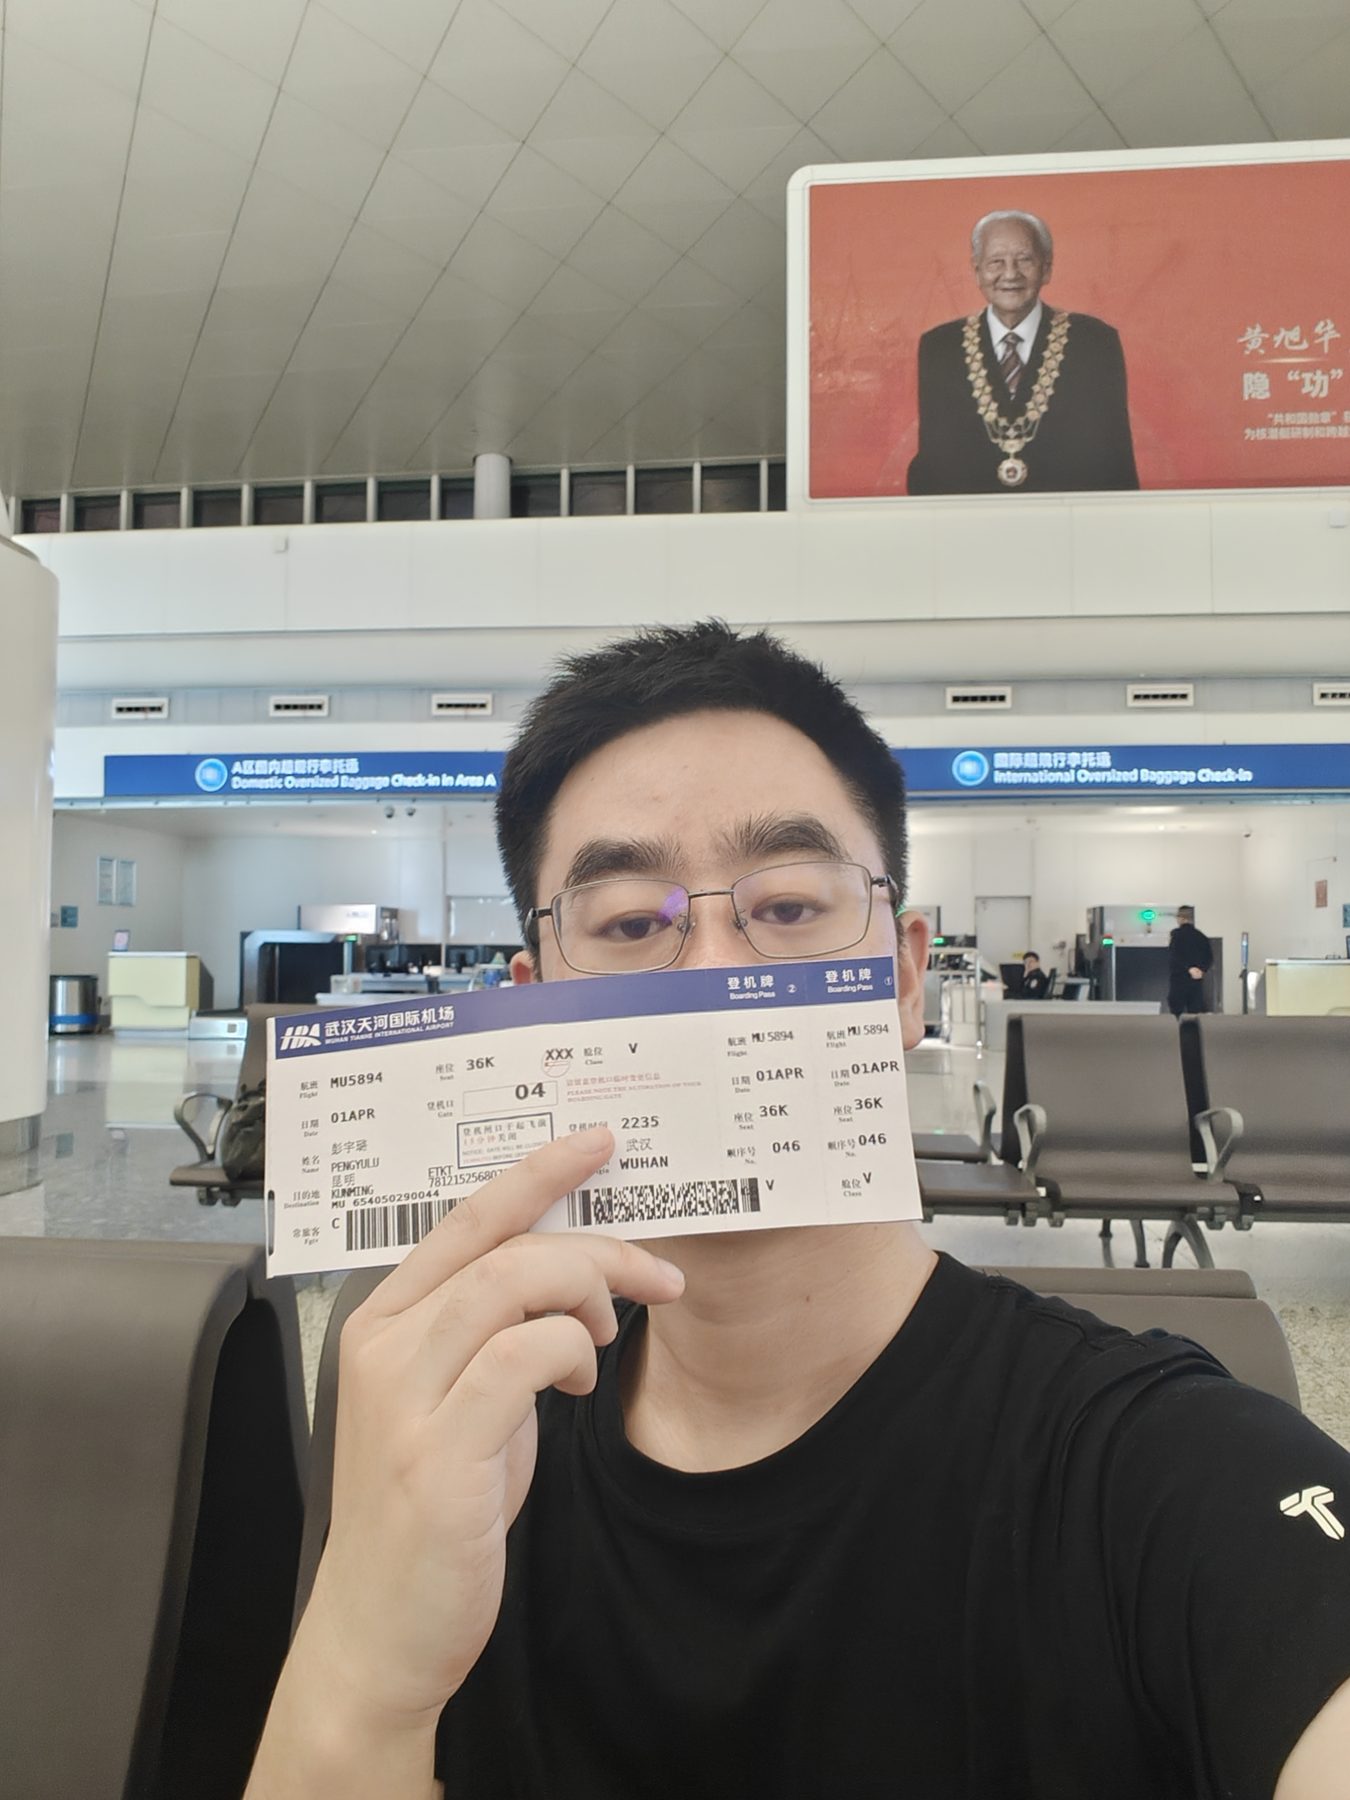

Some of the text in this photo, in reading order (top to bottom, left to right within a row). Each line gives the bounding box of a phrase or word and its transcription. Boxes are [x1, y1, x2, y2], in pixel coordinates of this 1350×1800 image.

[1237, 319, 1341, 355] 黄旭华
[231, 773, 497, 791] Domestic Oversized Baggage Check-in in Area A
[993, 768, 1253, 785] International Oversized Baggage Check-in
[727, 975, 774, 990] 登机牌
[825, 968, 872, 984] 登机牌
[729, 991, 776, 1000] Boarding Pass
[827, 984, 873, 994] Boarding Pass
[324, 1005, 455, 1037] 武汉天河国际机场
[325, 1021, 455, 1045] WUHAN TIANHE INTERNATIONAL AIRPORT
[826, 1030, 846, 1040] 航班
[628, 1043, 638, 1054] V
[727, 1037, 747, 1047] 航班
[545, 1048, 574, 1061] XXX
[583, 1046, 603, 1057] 舱位
[435, 1063, 455, 1073] 座位
[466, 1056, 495, 1071] 36K
[851, 1061, 900, 1075] 01APR
[330, 1072, 383, 1089] MU5894
[731, 1075, 751, 1086] 日期
[756, 1067, 805, 1082] 01APR
[831, 1069, 850, 1079] 日期
[300, 1080, 318, 1091] 航班
[515, 1082, 546, 1101] 04
[299, 1091, 318, 1099] Flight
[427, 1100, 454, 1111] 登机口
[833, 1105, 853, 1115] 座位
[854, 1097, 884, 1110] 36K
[330, 1108, 376, 1124] 01APR
[438, 1111, 453, 1119] Gate
[734, 1112, 754, 1122] 座位
[759, 1104, 789, 1118] 36K
[301, 1119, 320, 1130] 日期
[621, 1115, 660, 1130] 2235
[626, 1138, 653, 1152] 武汉
[858, 1133, 887, 1146] 046
[772, 1140, 801, 1154] 046
[302, 1155, 320, 1166] 姓名
[331, 1157, 380, 1173] PENGYULU
[619, 1155, 669, 1171] WUHAN
[428, 1165, 454, 1178] ETKT
[862, 1172, 872, 1184] V
[331, 1173, 356, 1188] 昆明
[765, 1179, 775, 1191] V
[841, 1179, 862, 1189] 舱位
[292, 1190, 320, 1201] 目的地
[331, 1185, 374, 1200] KUNMING
[331, 1189, 440, 1209] MU 654050290044
[283, 1201, 320, 1209] Destination
[331, 1217, 340, 1230] C
